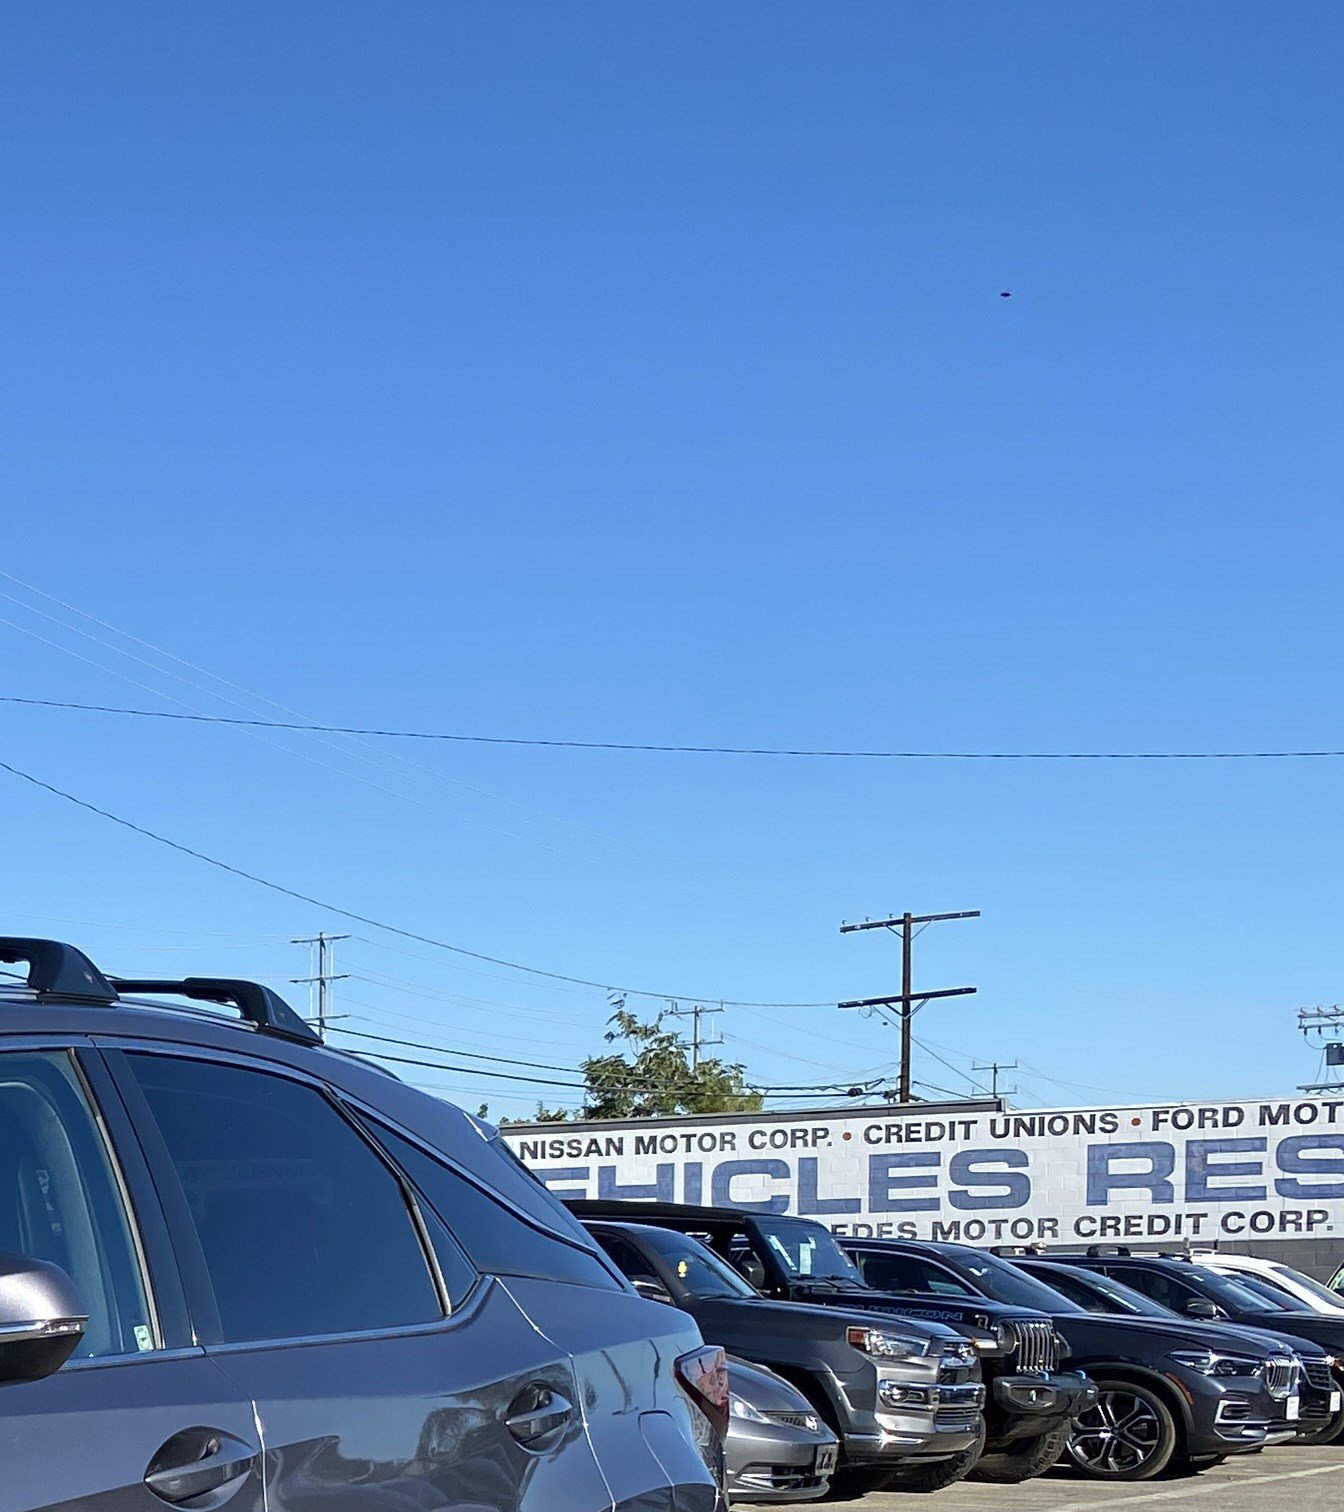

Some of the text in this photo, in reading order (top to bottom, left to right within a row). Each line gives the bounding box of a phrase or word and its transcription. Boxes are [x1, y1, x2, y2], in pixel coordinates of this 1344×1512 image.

[519, 1101, 1344, 1160] NISSAN MOTOR CORP. CREDIT UNIONS FORD MOT
[1086, 1133, 1344, 1206] RES
[931, 1217, 1060, 1242] MOTOR
[1073, 1212, 1209, 1238] CREDIT
[1220, 1209, 1334, 1235] CORP.
